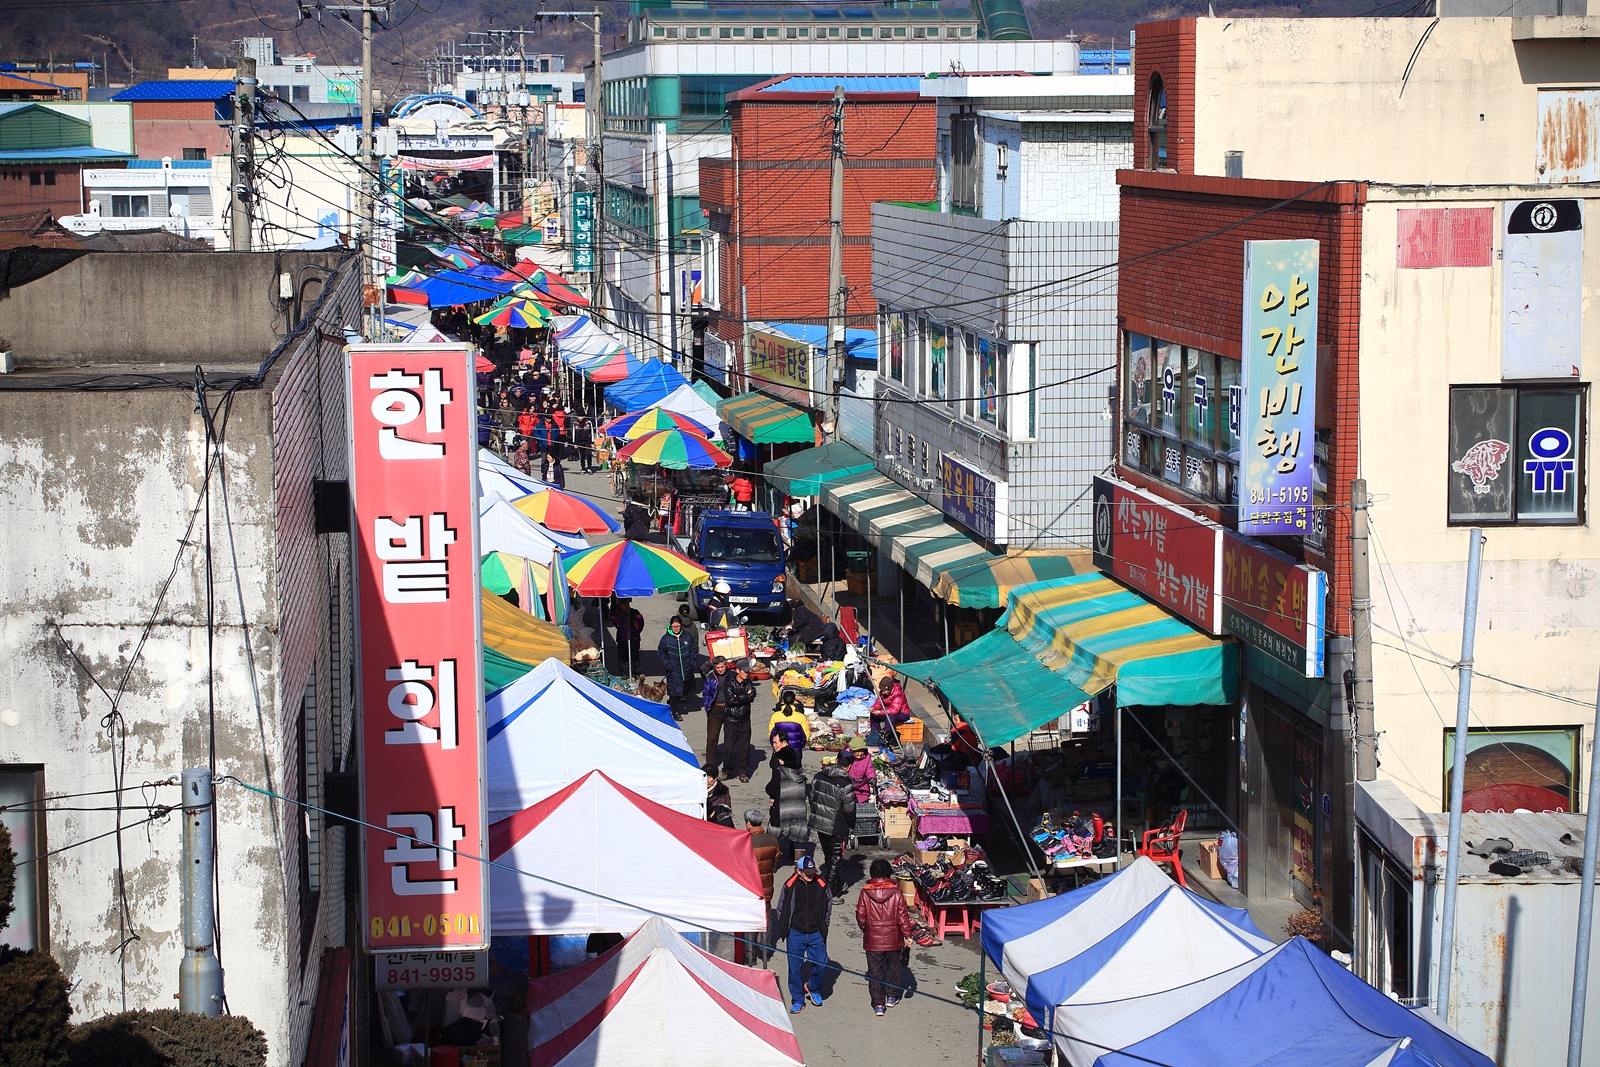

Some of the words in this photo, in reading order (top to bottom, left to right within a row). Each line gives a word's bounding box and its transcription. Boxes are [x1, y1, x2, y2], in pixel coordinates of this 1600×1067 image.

[749, 333, 807, 385] 유구의류타운
[1257, 274, 1310, 475] 야간비행
[1524, 427, 1576, 493] 유
[1250, 486, 1308, 504] 841-5195
[1250, 511, 1293, 525] 단란주점
[369, 367, 466, 896] 한밭회관
[370, 912, 480, 938] 841-0501
[387, 966, 476, 985] 841-9935
